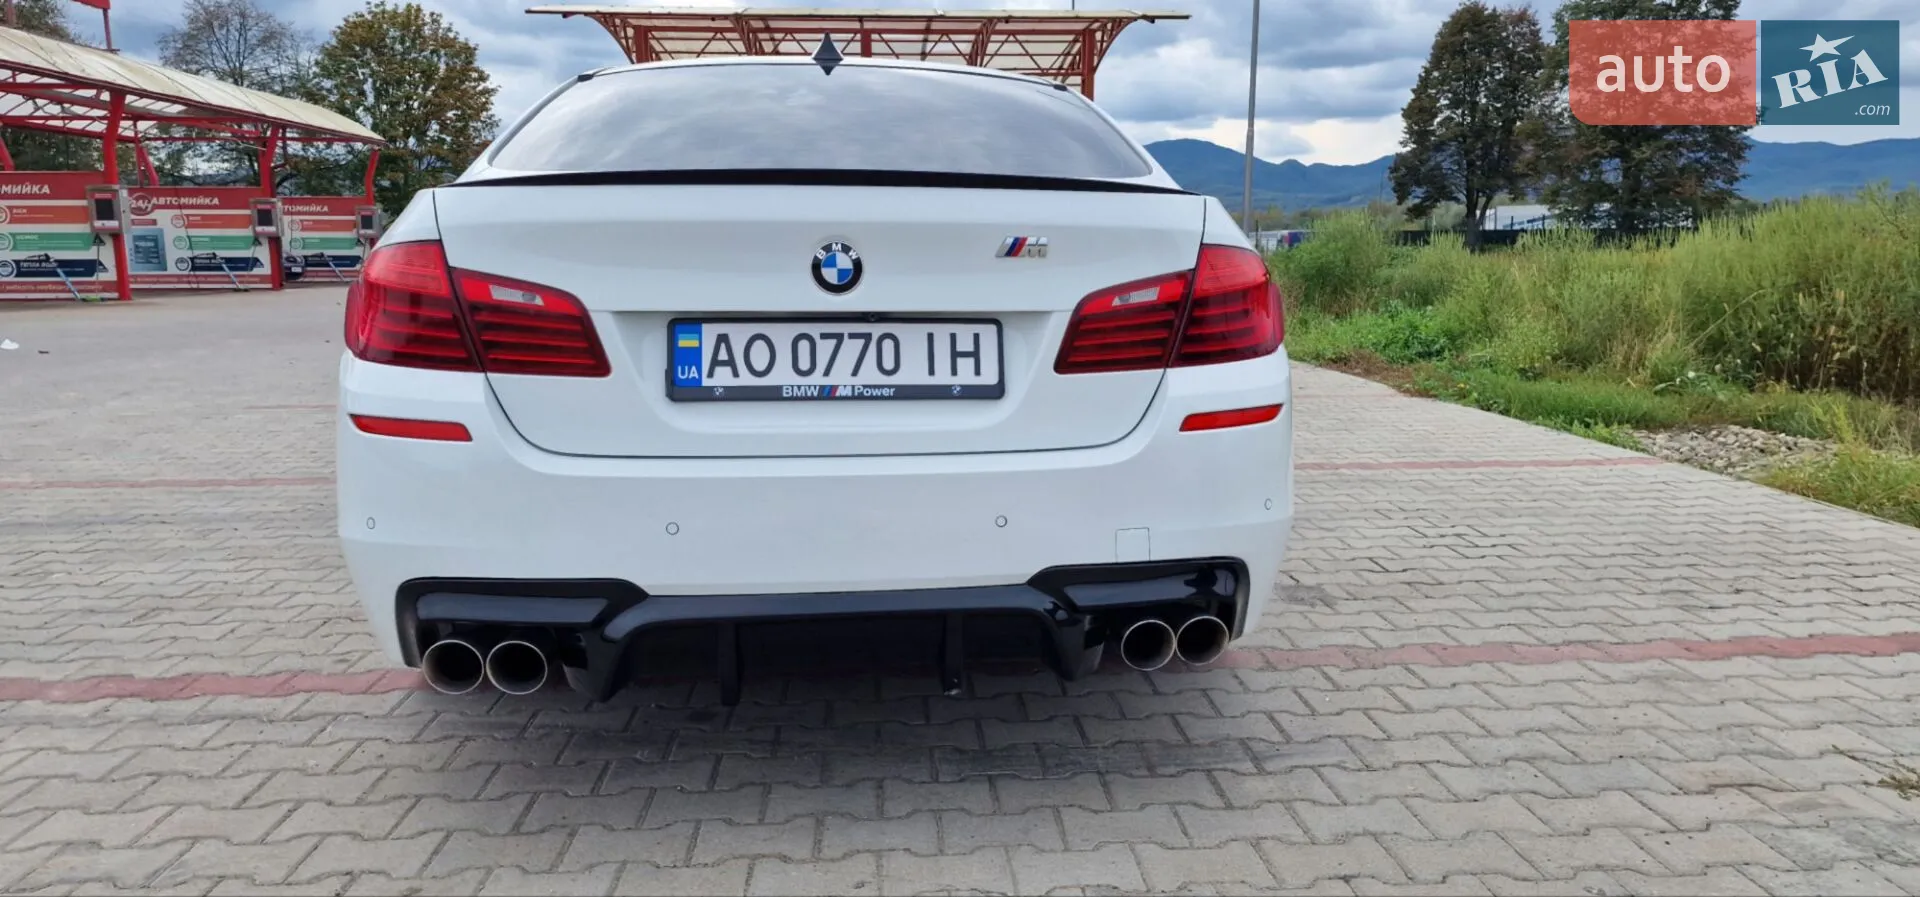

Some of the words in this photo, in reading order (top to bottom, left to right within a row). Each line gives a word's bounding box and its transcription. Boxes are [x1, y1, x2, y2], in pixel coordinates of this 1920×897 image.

[150, 196, 220, 206] АВТОМИЙКА
[815, 242, 859, 260] BMW
[706, 333, 777, 379] AO
[791, 332, 900, 377] 0770
[927, 332, 981, 377] IH
[677, 366, 699, 380] UA
[782, 385, 820, 398] BMW
[854, 385, 896, 397] Power
